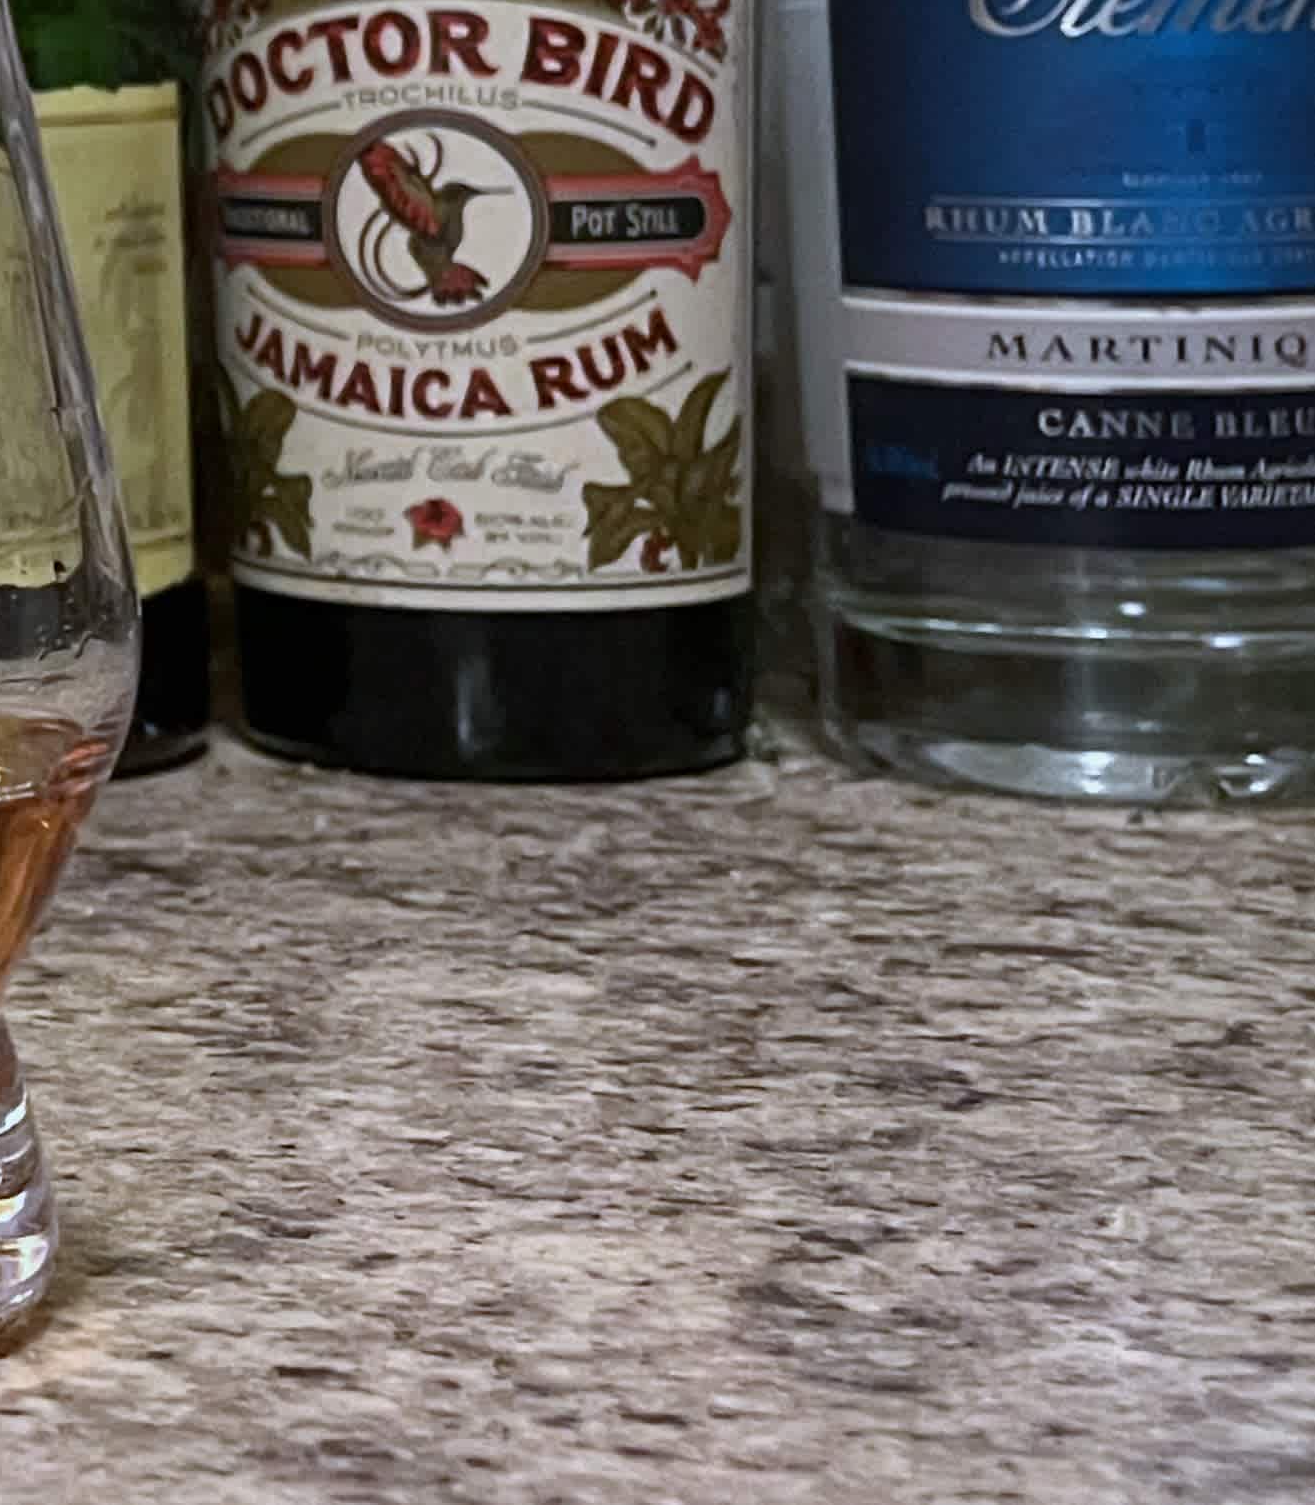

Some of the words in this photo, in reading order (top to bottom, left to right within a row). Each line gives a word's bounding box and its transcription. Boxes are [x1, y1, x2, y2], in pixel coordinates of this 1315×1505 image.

[206, 8, 499, 143] DOCTOR
[520, 16, 716, 145] BIRD
[341, 81, 523, 112] TROCHILUS
[923, 205, 1049, 237] RHUM
[355, 333, 523, 360] POLYTMUS
[987, 331, 1308, 369] MARTINIQ
[235, 312, 514, 421] JAMAICA
[529, 309, 679, 410] RUM
[1037, 408, 1195, 439] CANNE
[1003, 455, 1119, 480] INTENSE
[1116, 483, 1211, 509] SINGLE
